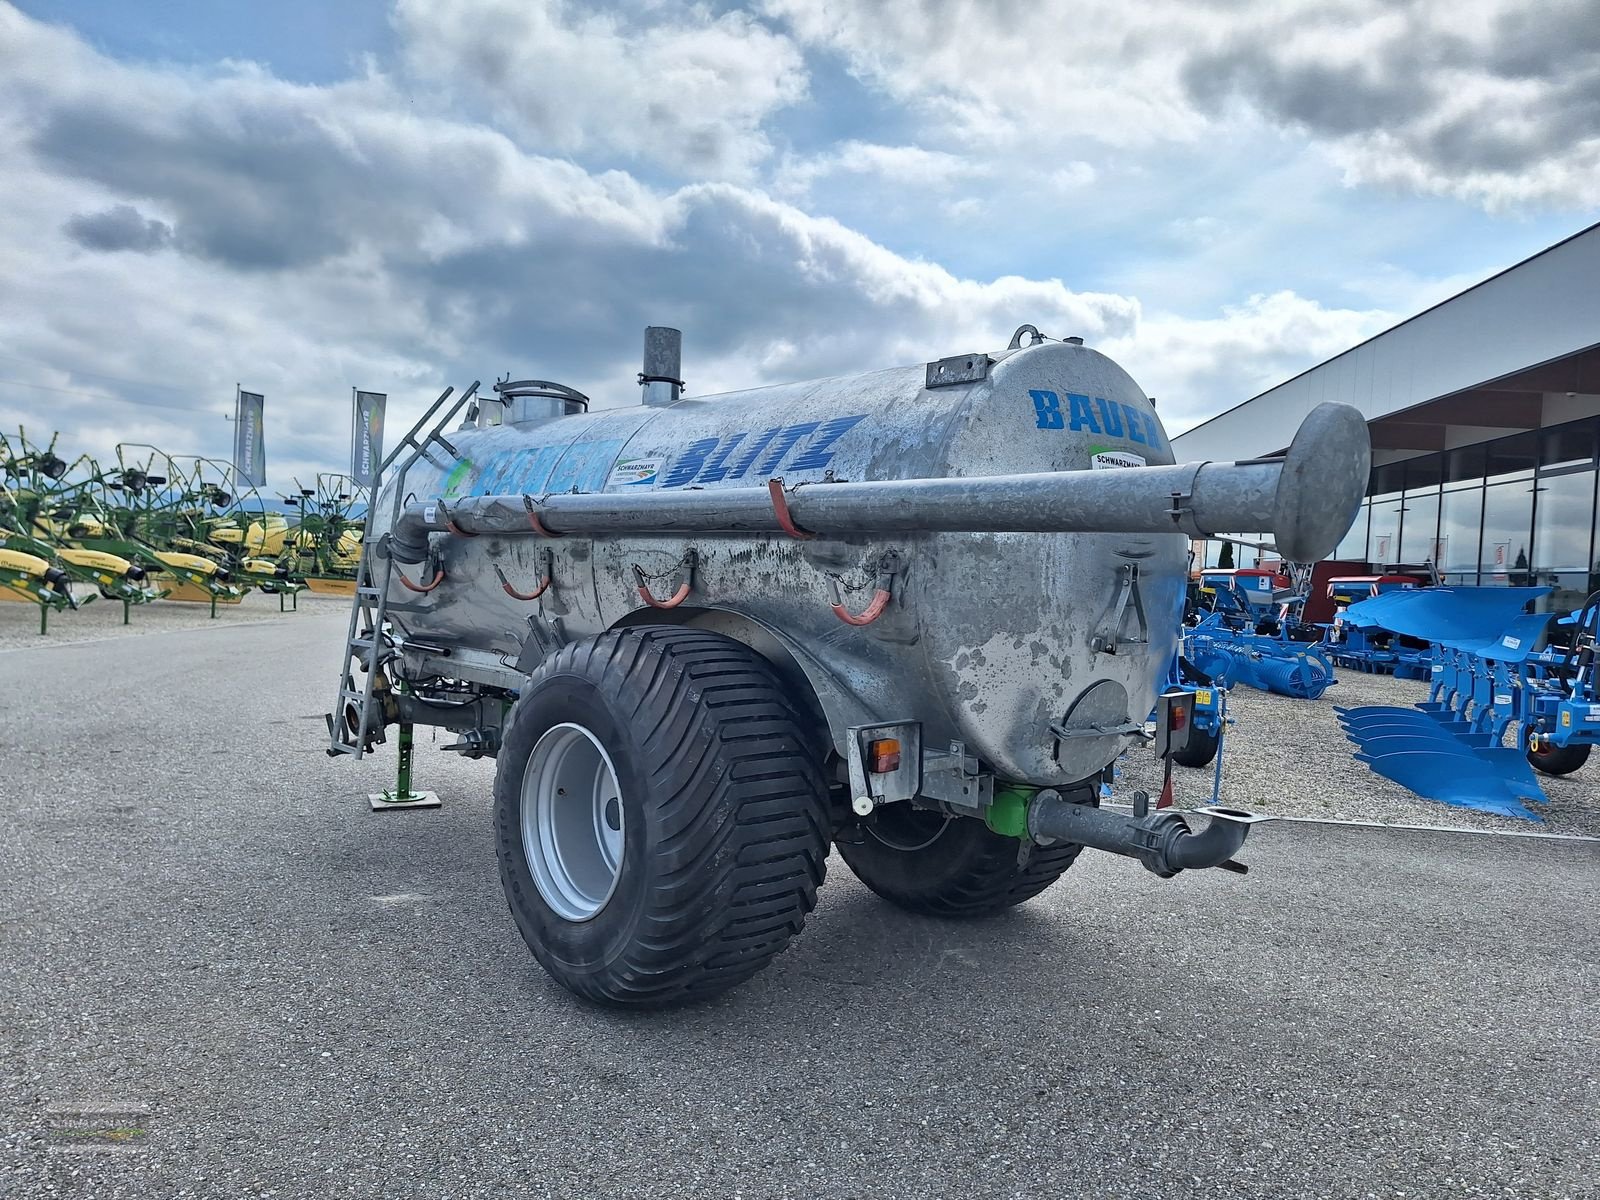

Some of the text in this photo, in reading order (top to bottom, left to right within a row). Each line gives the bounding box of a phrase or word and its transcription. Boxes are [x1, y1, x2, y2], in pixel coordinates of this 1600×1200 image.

[660, 414, 870, 488] BLITZ
[1029, 389, 1162, 452] BAUER
[617, 463, 655, 472] SCHWARZMAYR
